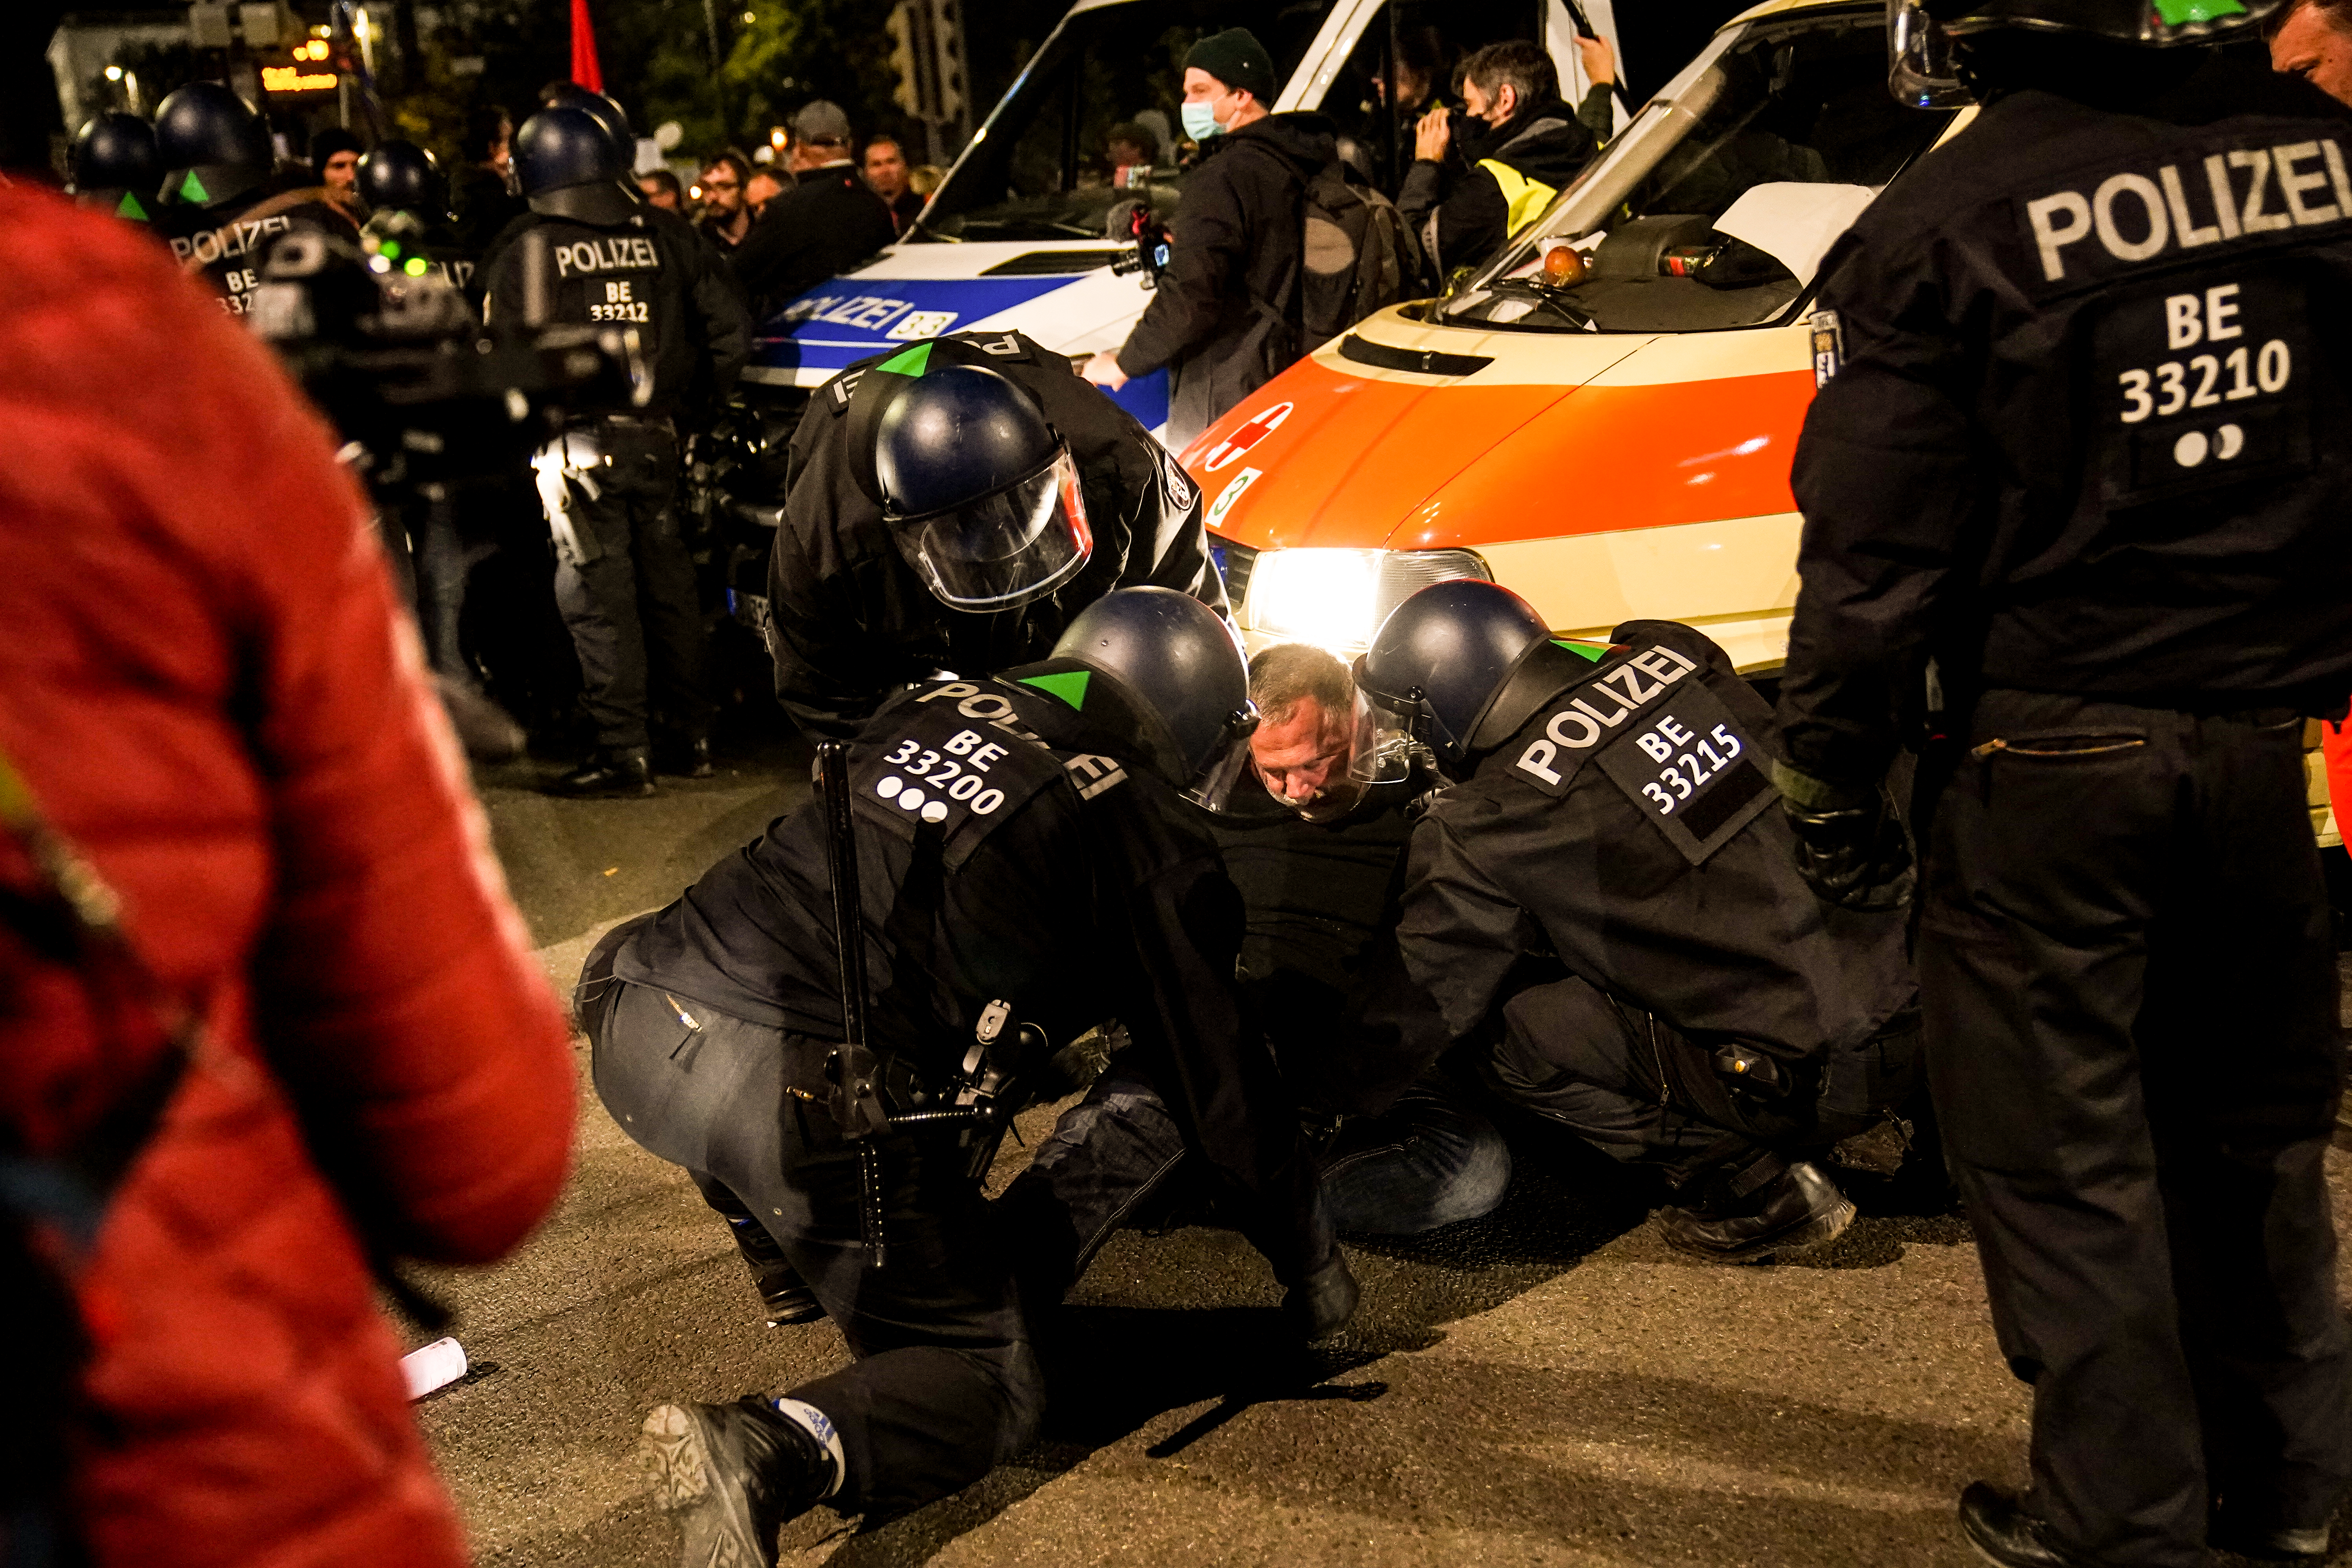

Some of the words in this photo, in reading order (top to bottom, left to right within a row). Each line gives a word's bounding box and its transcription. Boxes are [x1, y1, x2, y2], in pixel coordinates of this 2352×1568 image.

[2027, 138, 2352, 282] POLIZEI
[225, 269, 259, 292] BE
[554, 238, 659, 278] POLIZEI
[590, 301, 650, 323] 33212
[606, 281, 632, 303] BE
[2165, 283, 2243, 350] BE
[898, 316, 947, 336] 33
[2118, 339, 2290, 423] 33210
[915, 682, 1129, 800] POLEI
[1516, 645, 1697, 786] POLIZEI
[1635, 715, 1695, 764] BE
[883, 740, 1004, 815] 33200
[943, 730, 1009, 772] BE
[1642, 723, 1742, 815] 33215
